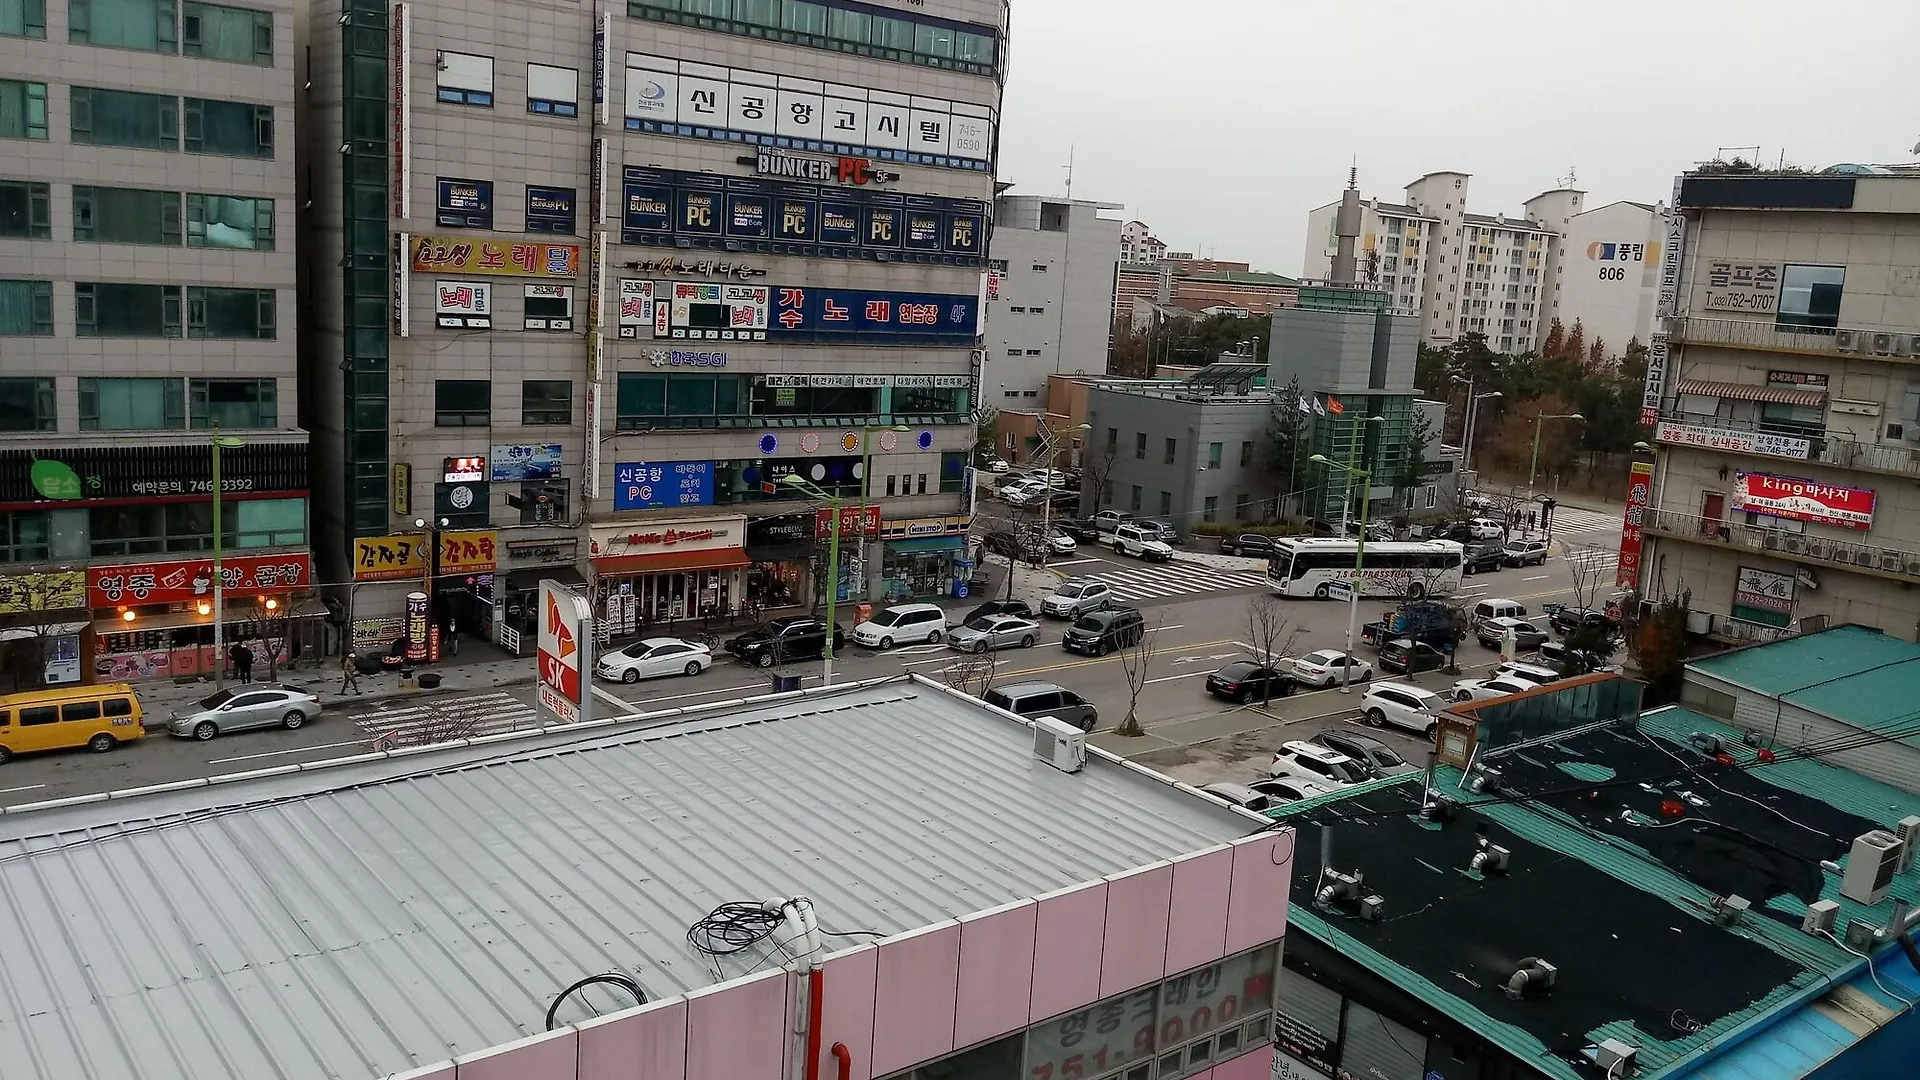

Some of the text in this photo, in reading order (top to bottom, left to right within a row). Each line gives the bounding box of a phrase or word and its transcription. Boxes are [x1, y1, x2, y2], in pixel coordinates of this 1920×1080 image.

[690, 90, 940, 143] 신공항고시텔
[959, 124, 981, 137] 746-
[758, 145, 772, 154] THE
[957, 140, 980, 151] 0590
[757, 154, 889, 185] BUNKER PC 5F
[450, 187, 478, 197] BUNKER
[531, 201, 569, 211] BUNKER PC
[630, 200, 667, 213] BUNKER
[687, 196, 712, 205] BUNKER
[686, 206, 712, 227] PC
[734, 204, 763, 214] BUNKER
[784, 204, 806, 214] BUNKER
[783, 215, 806, 234] PC
[824, 217, 855, 229] BUNKER
[872, 213, 893, 221] BUNKER
[911, 220, 936, 229] BUNKER
[953, 220, 973, 228] BUNKER
[871, 222, 892, 241] PC
[952, 229, 972, 247] PC
[477, 243, 538, 274] 노래
[1618, 243, 1644, 261] 풍림
[1598, 267, 1625, 281] 806
[1709, 263, 1778, 290] 골프존
[623, 282, 653, 297] 고고씽
[726, 288, 766, 304] 고고씽
[439, 287, 473, 309] 노래
[779, 288, 805, 329] 가수
[899, 303, 939, 325] 연습장
[1663, 429, 1682, 442] 영종
[1686, 433, 1707, 445] 최대
[1711, 436, 1753, 451] 실내공간
[1794, 438, 1806, 448] 4F
[619, 467, 663, 484] 신공항
[189, 478, 253, 492] 7463392
[628, 485, 652, 501] PC
[359, 541, 411, 568] 감자골
[97, 574, 156, 601] 영종
[408, 602, 427, 612] 가수
[547, 657, 565, 694] SK
